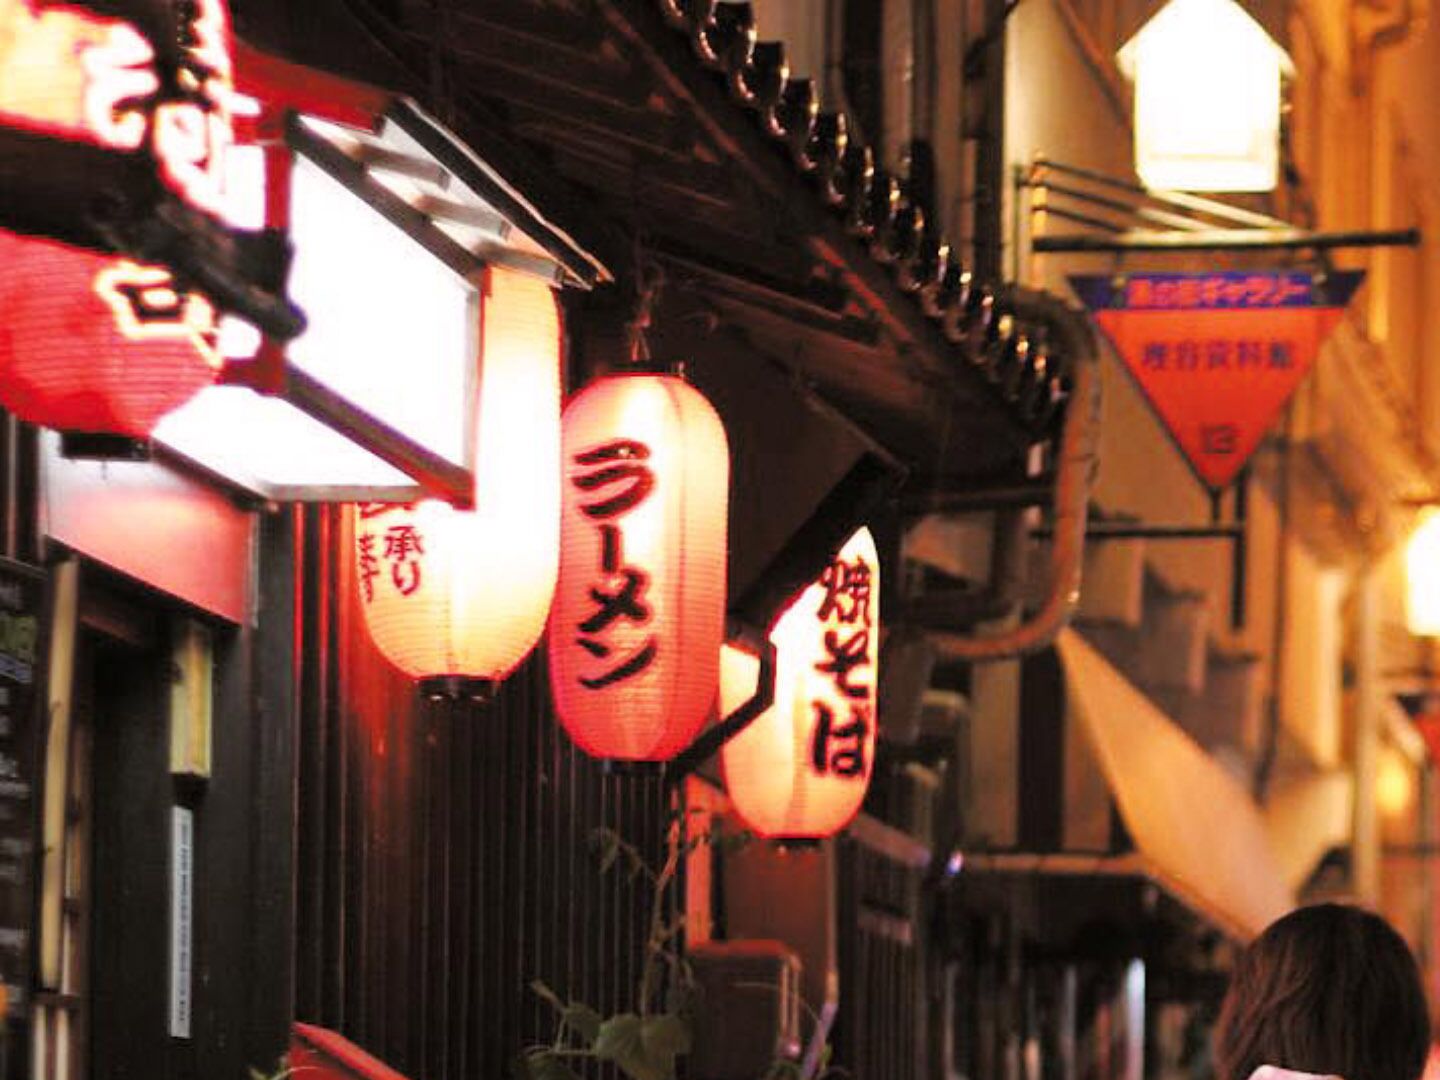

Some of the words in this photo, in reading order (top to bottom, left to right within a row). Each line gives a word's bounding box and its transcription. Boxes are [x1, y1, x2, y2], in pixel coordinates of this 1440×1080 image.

[575, 440, 655, 690] ラーメン
[815, 556, 872, 778] 焼そば
